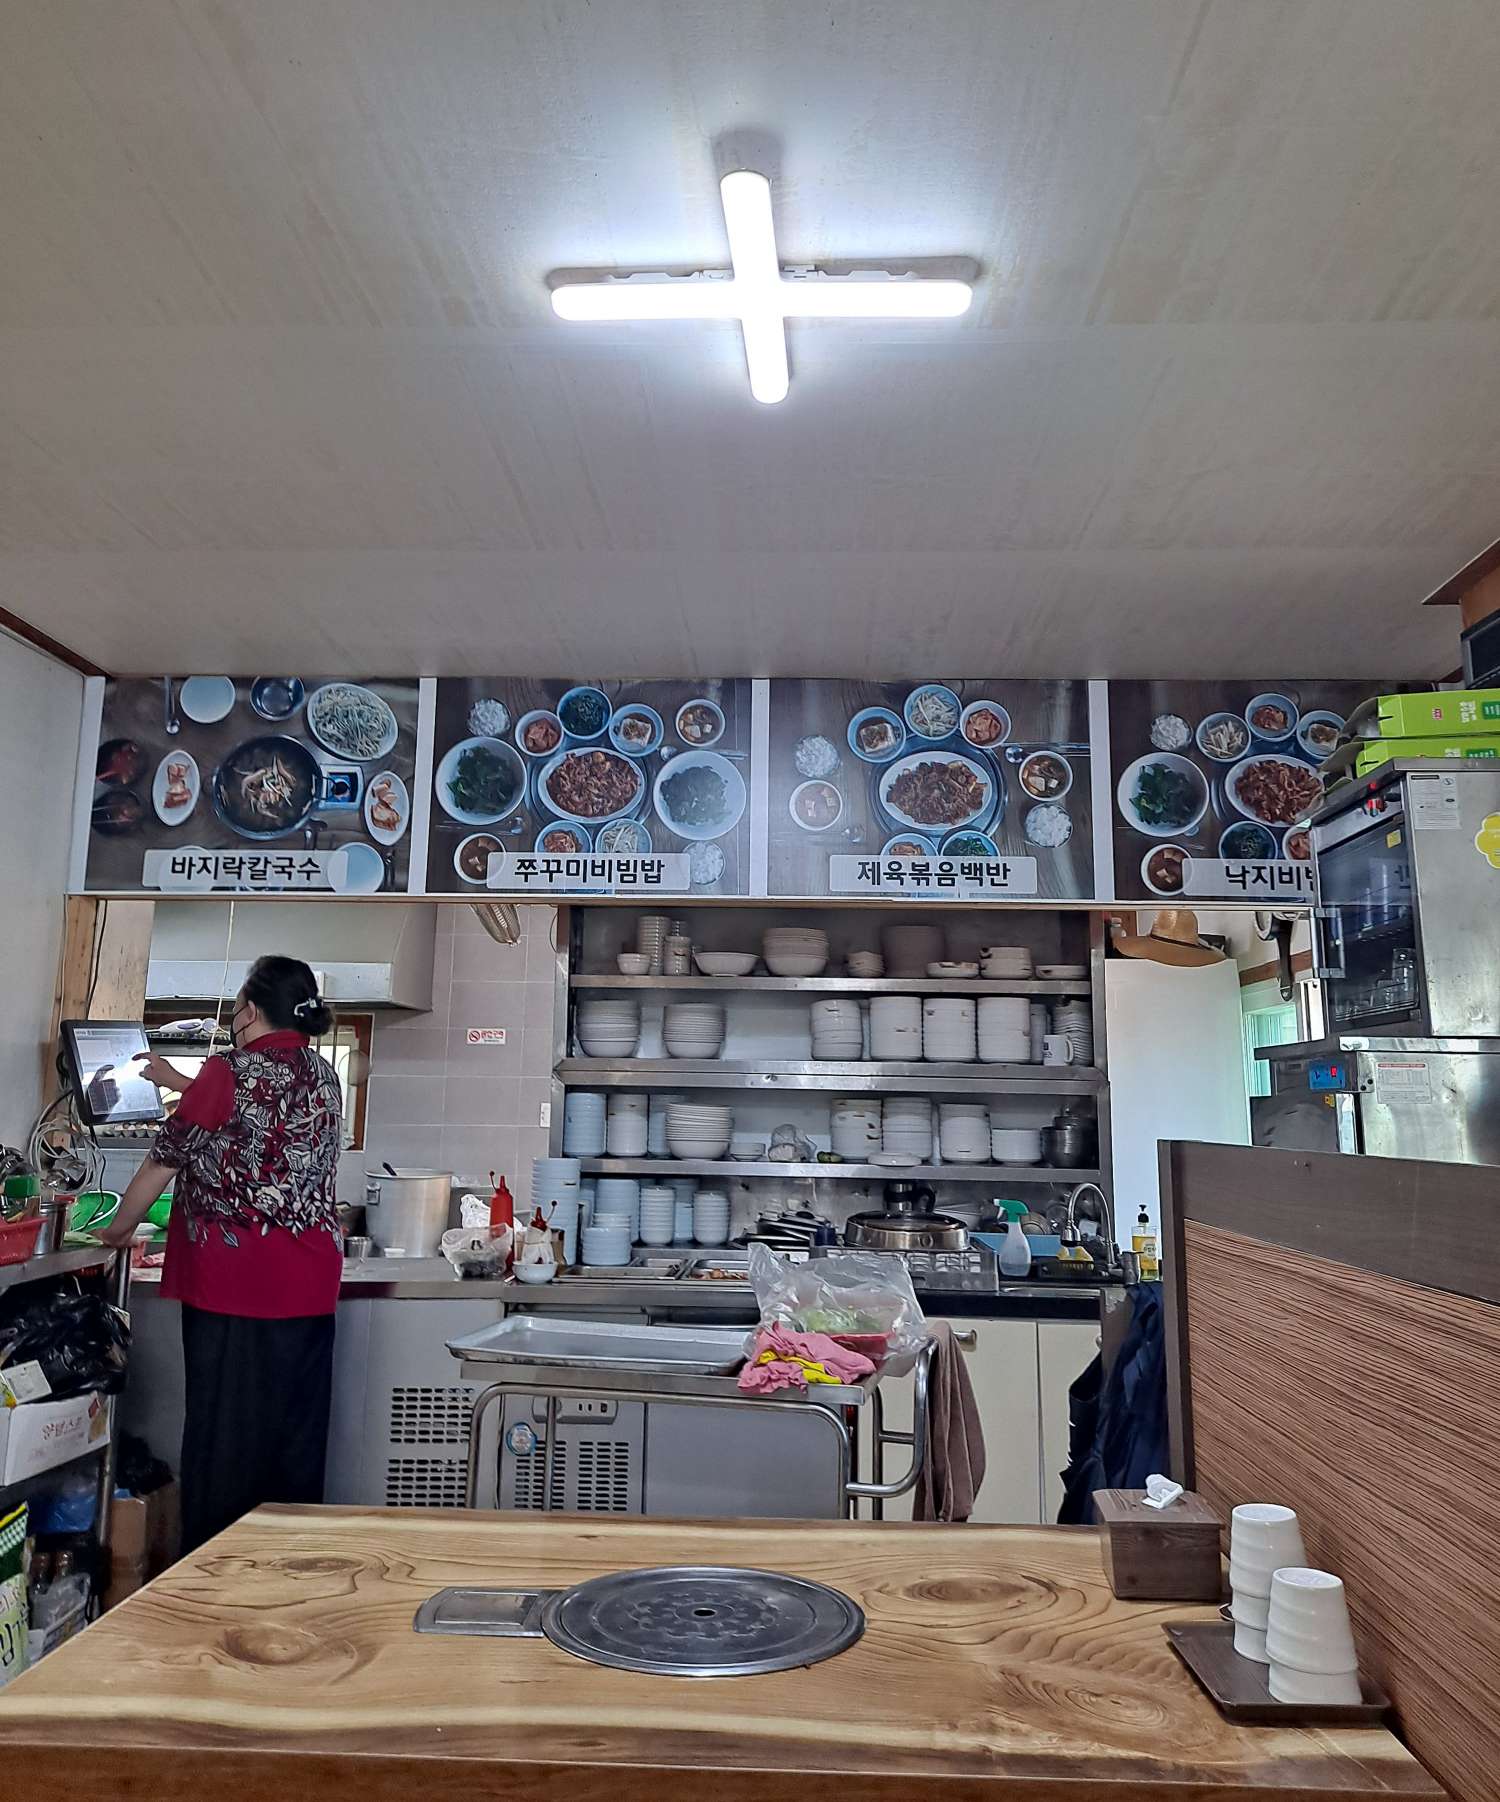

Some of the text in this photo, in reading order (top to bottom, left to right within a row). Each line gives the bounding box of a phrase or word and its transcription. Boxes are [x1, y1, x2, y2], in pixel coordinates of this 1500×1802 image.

[171, 856, 321, 881] 바지락칼국수
[514, 858, 665, 884] 쭈꾸미비빔밥
[857, 860, 1011, 887] 제육볶음백반
